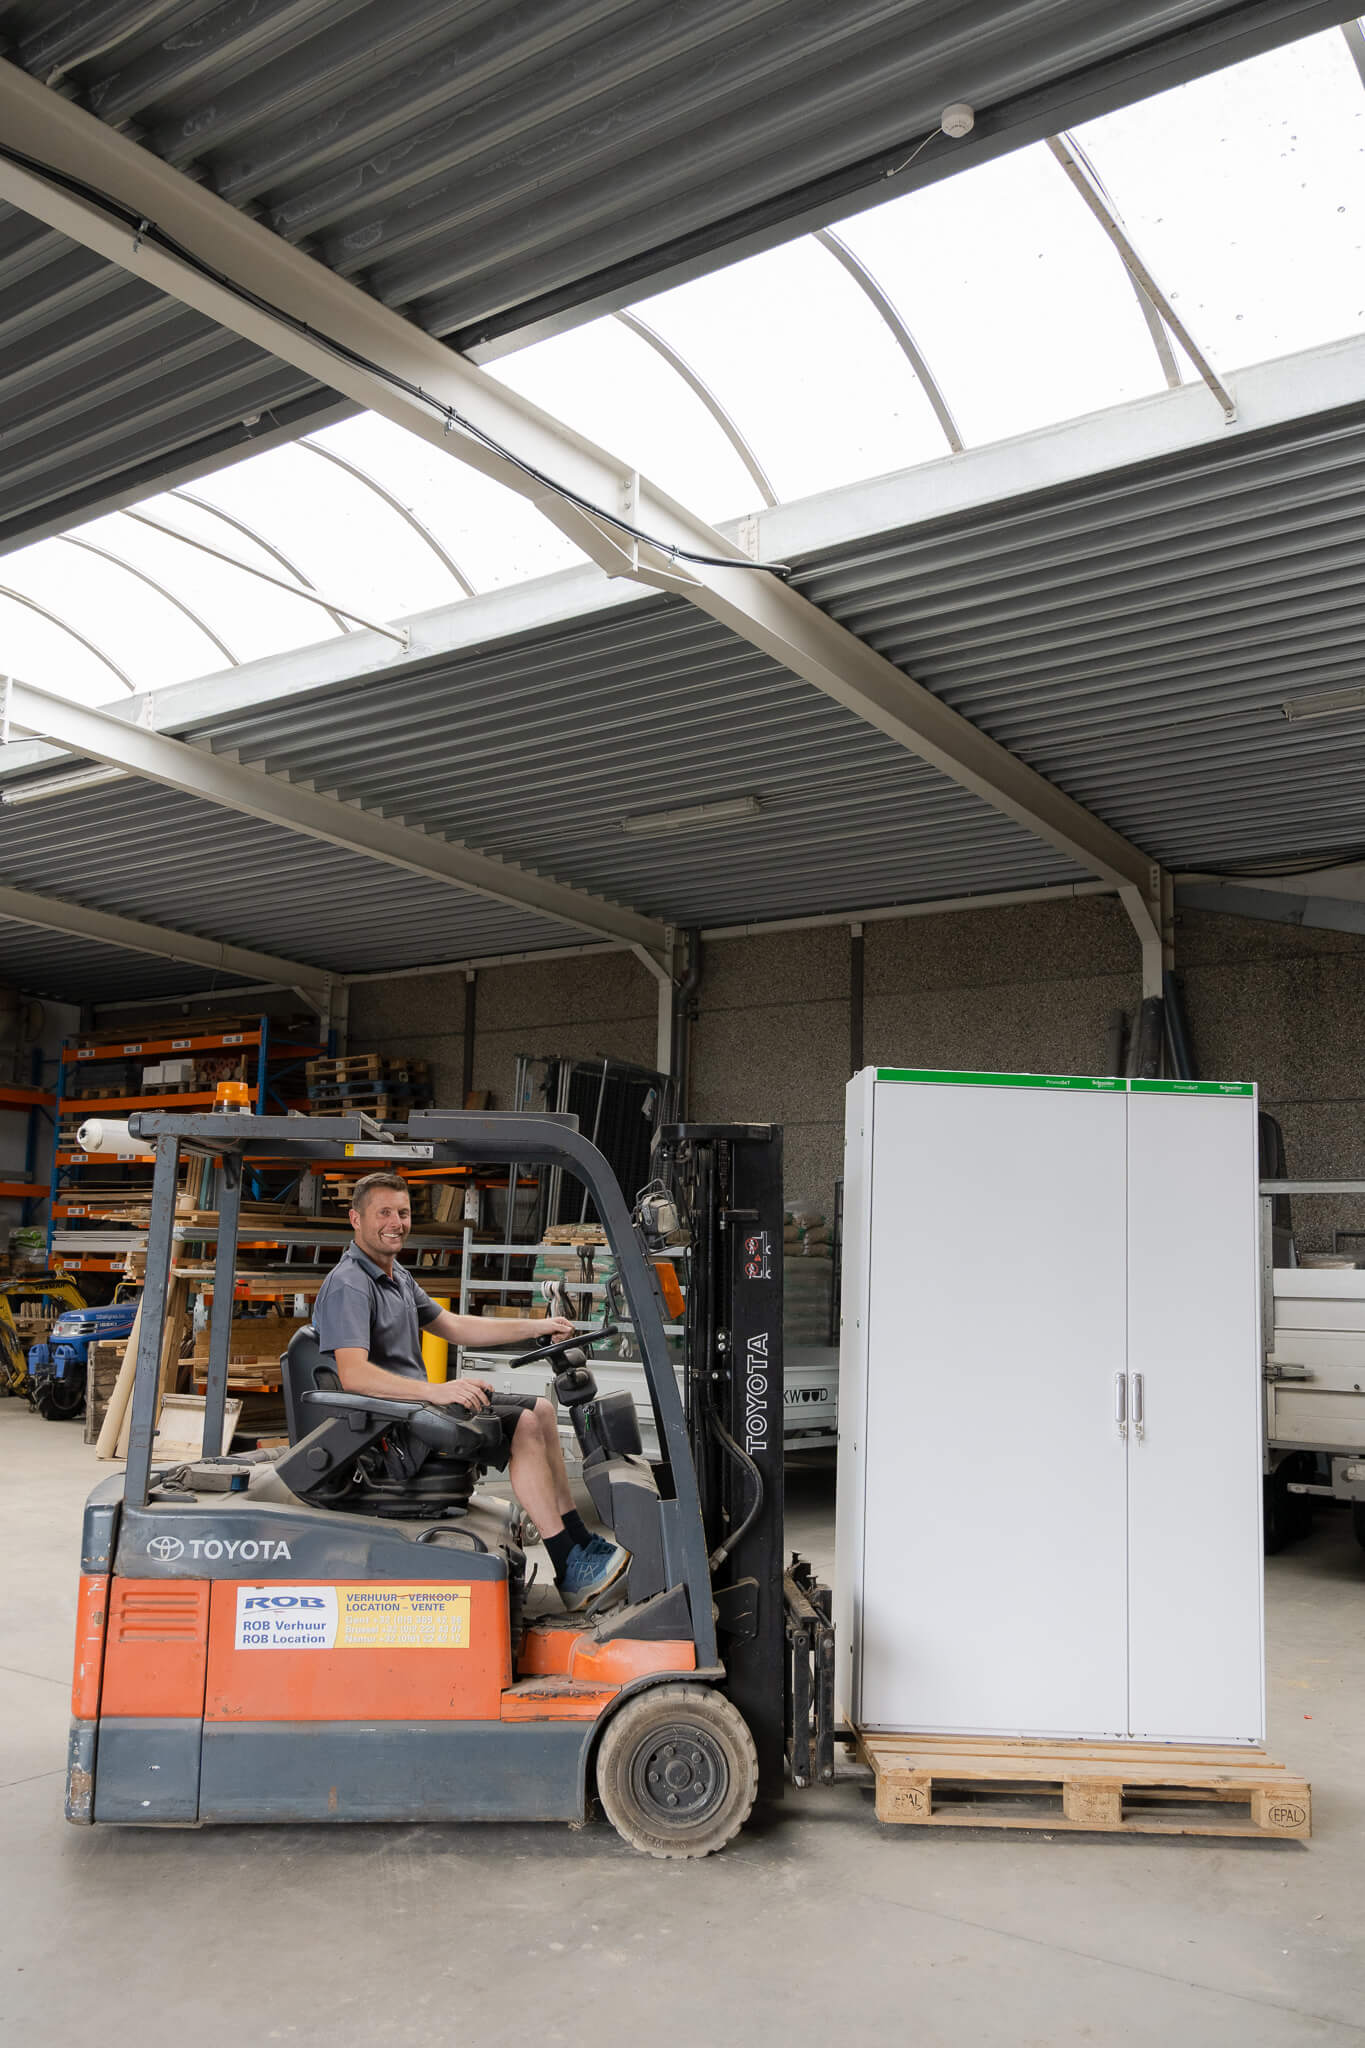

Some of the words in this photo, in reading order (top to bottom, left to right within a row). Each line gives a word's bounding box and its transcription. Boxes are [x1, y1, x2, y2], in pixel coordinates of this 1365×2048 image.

[746, 1332, 768, 1455] TOYOTA
[189, 1540, 292, 1560] TOYOTA
[245, 1596, 326, 1609] ROB
[346, 1593, 397, 1602] VERHUUR
[408, 1593, 459, 1602] VERKOOP
[346, 1603, 400, 1611] LOCATION
[411, 1603, 445, 1611] VENTE
[243, 1621, 271, 1630] ROB
[275, 1621, 327, 1630] Verhuur
[243, 1634, 269, 1643] ROB
[272, 1634, 326, 1643] Location
[1273, 1808, 1300, 1822] EPAL
